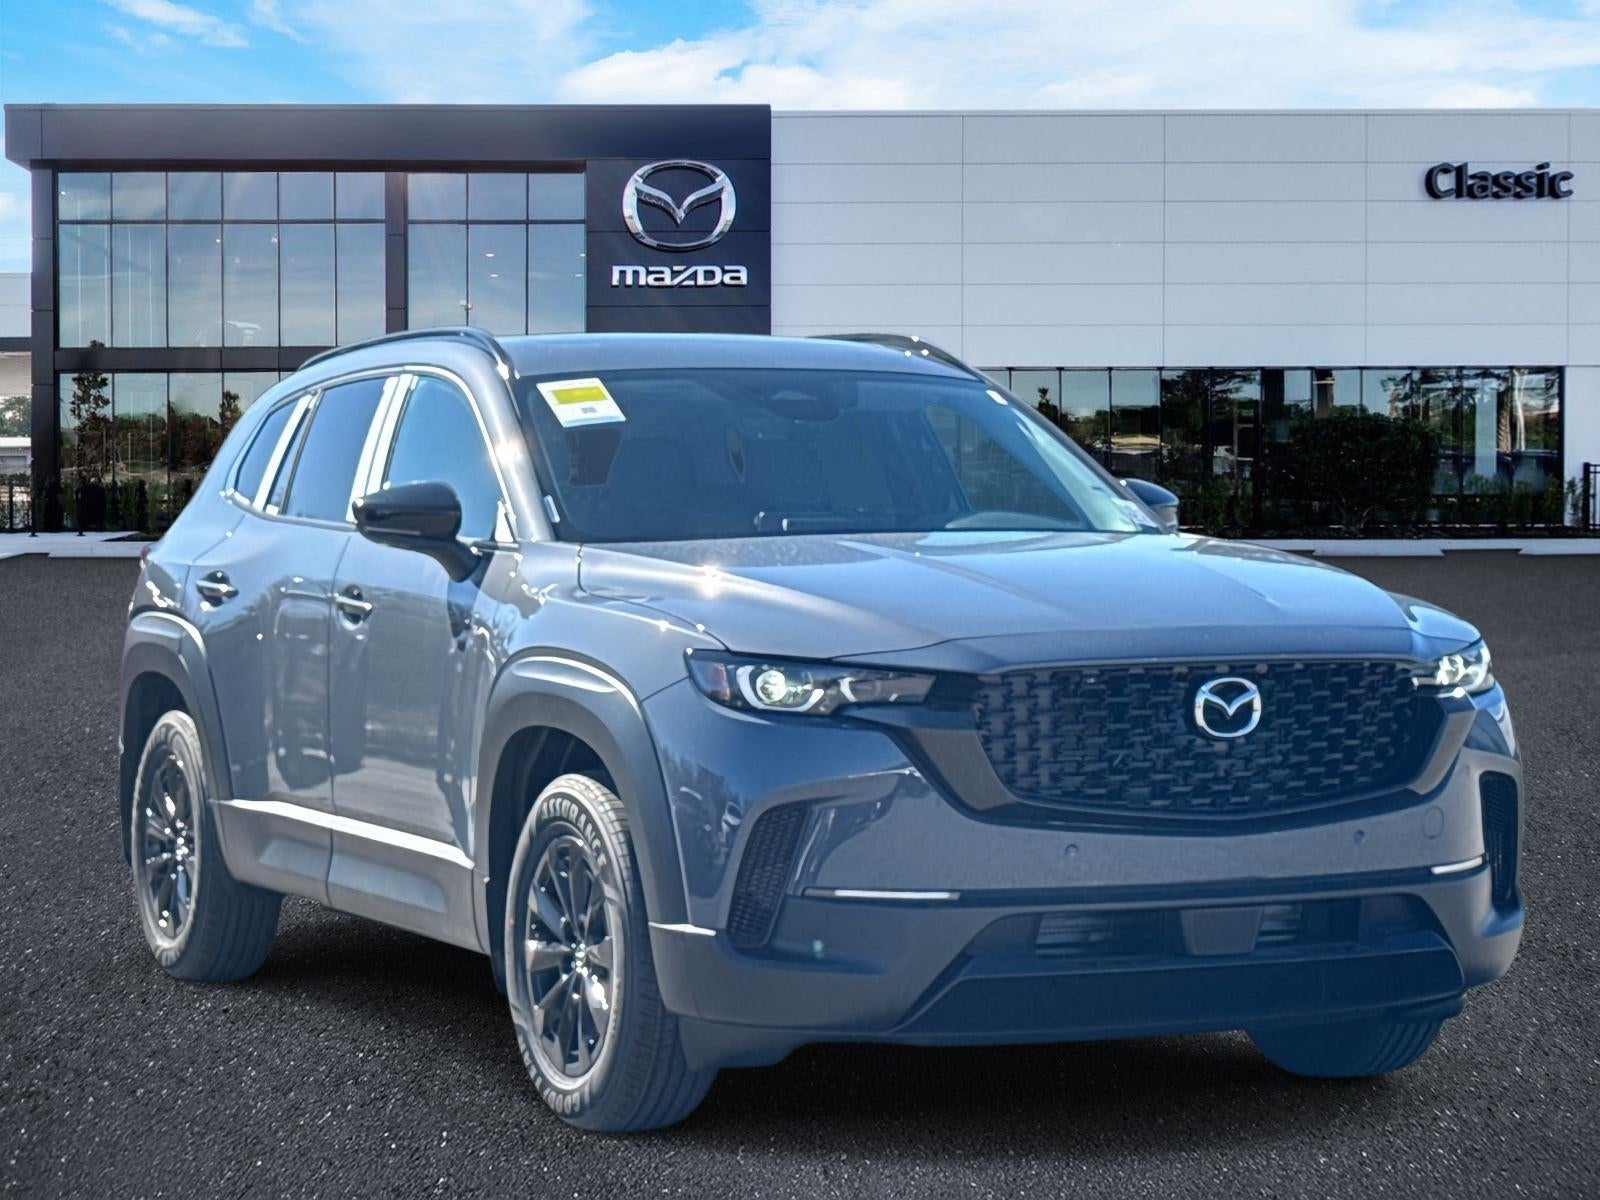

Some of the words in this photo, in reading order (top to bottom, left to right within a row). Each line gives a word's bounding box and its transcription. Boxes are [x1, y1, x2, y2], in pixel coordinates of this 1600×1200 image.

[1424, 161, 1575, 200] Classic
[611, 265, 748, 287] mazda
[541, 797, 607, 867] ASSURANCE
